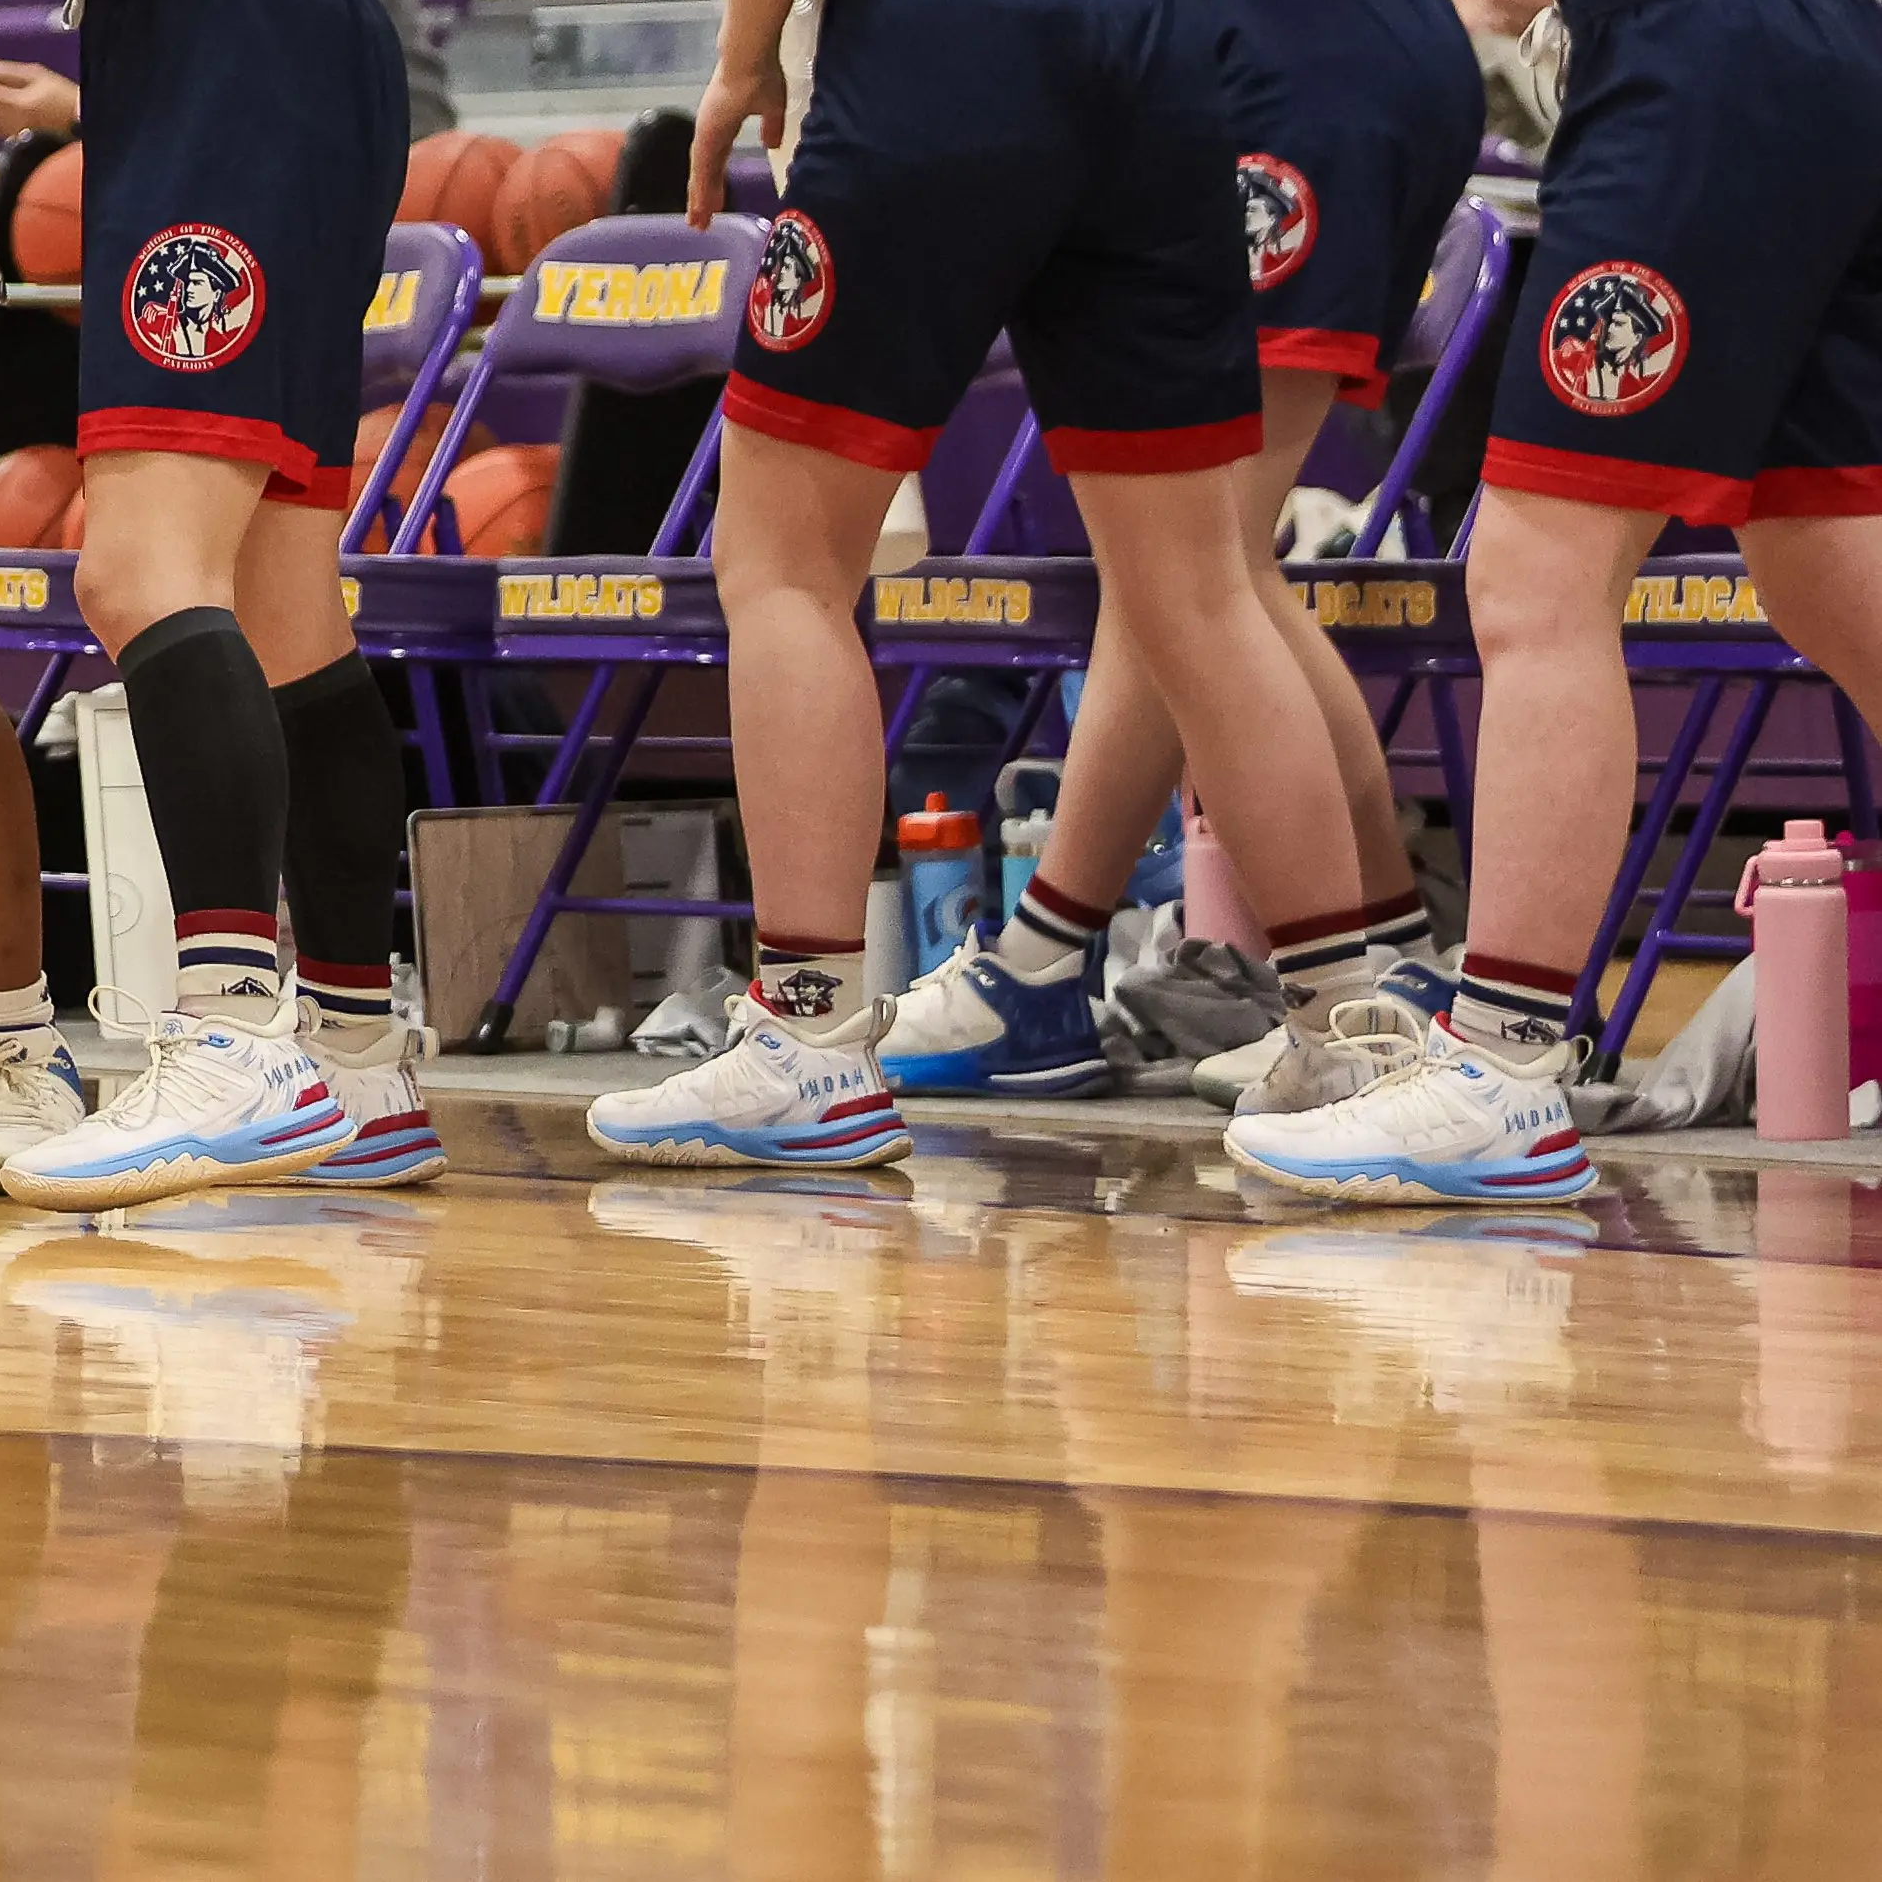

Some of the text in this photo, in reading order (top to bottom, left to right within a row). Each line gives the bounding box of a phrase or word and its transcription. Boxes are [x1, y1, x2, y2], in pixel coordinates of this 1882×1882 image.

[138, 224, 258, 269] SCHOOL OF THE OZARKS
[534, 258, 731, 327] VERONA
[162, 357, 215, 370] PATRIOTS
[497, 573, 665, 620] WILDCATS
[874, 576, 1032, 625] WILDCATS
